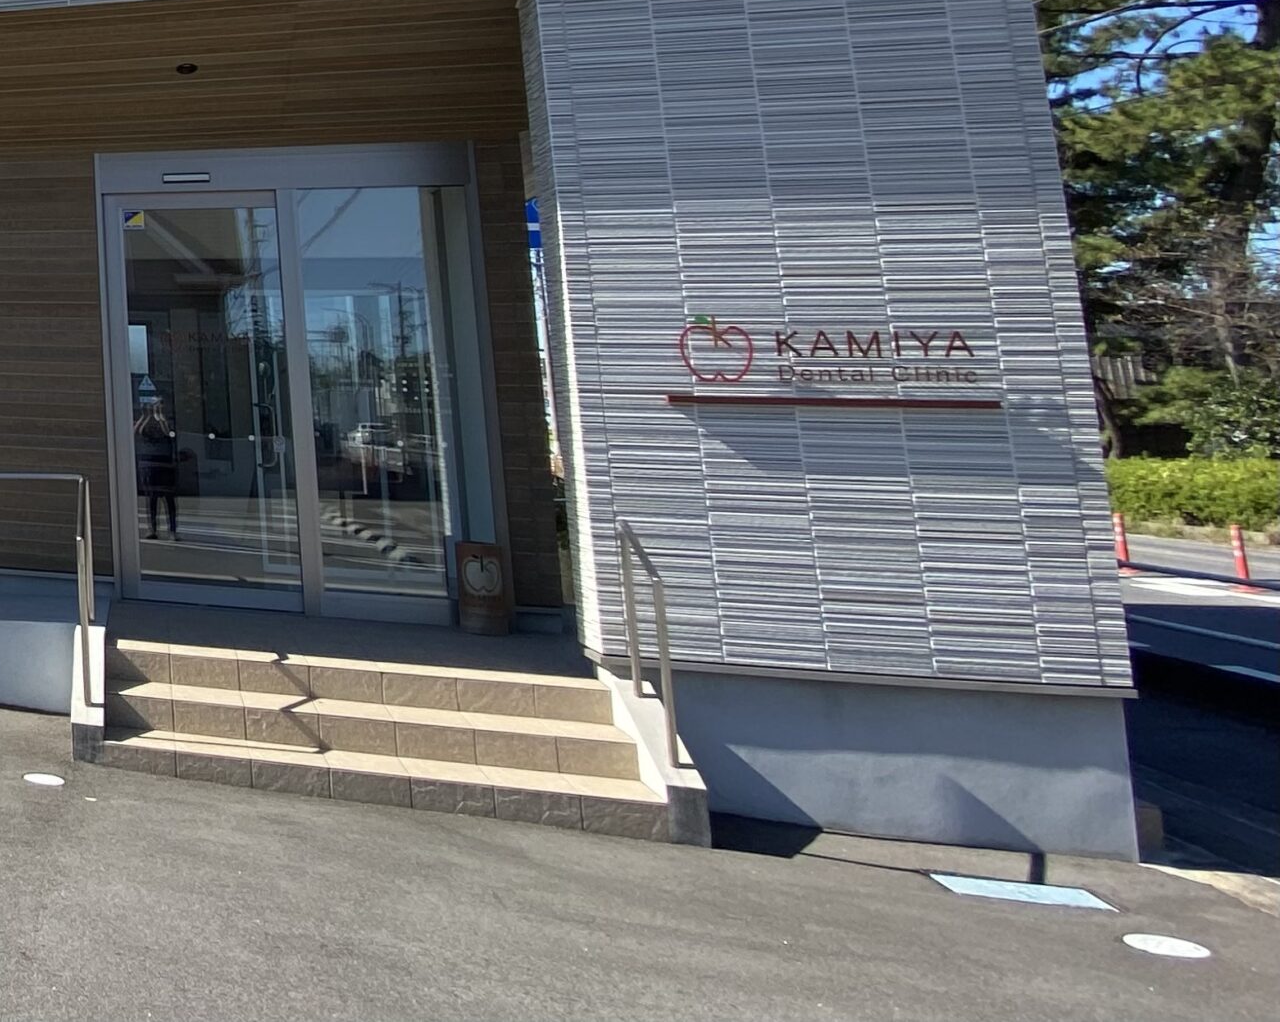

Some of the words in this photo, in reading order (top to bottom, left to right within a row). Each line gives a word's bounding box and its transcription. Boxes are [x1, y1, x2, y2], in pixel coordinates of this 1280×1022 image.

[775, 330, 976, 358] KAMIYA
[778, 365, 874, 384] Dental
[892, 366, 979, 385] Clinic
